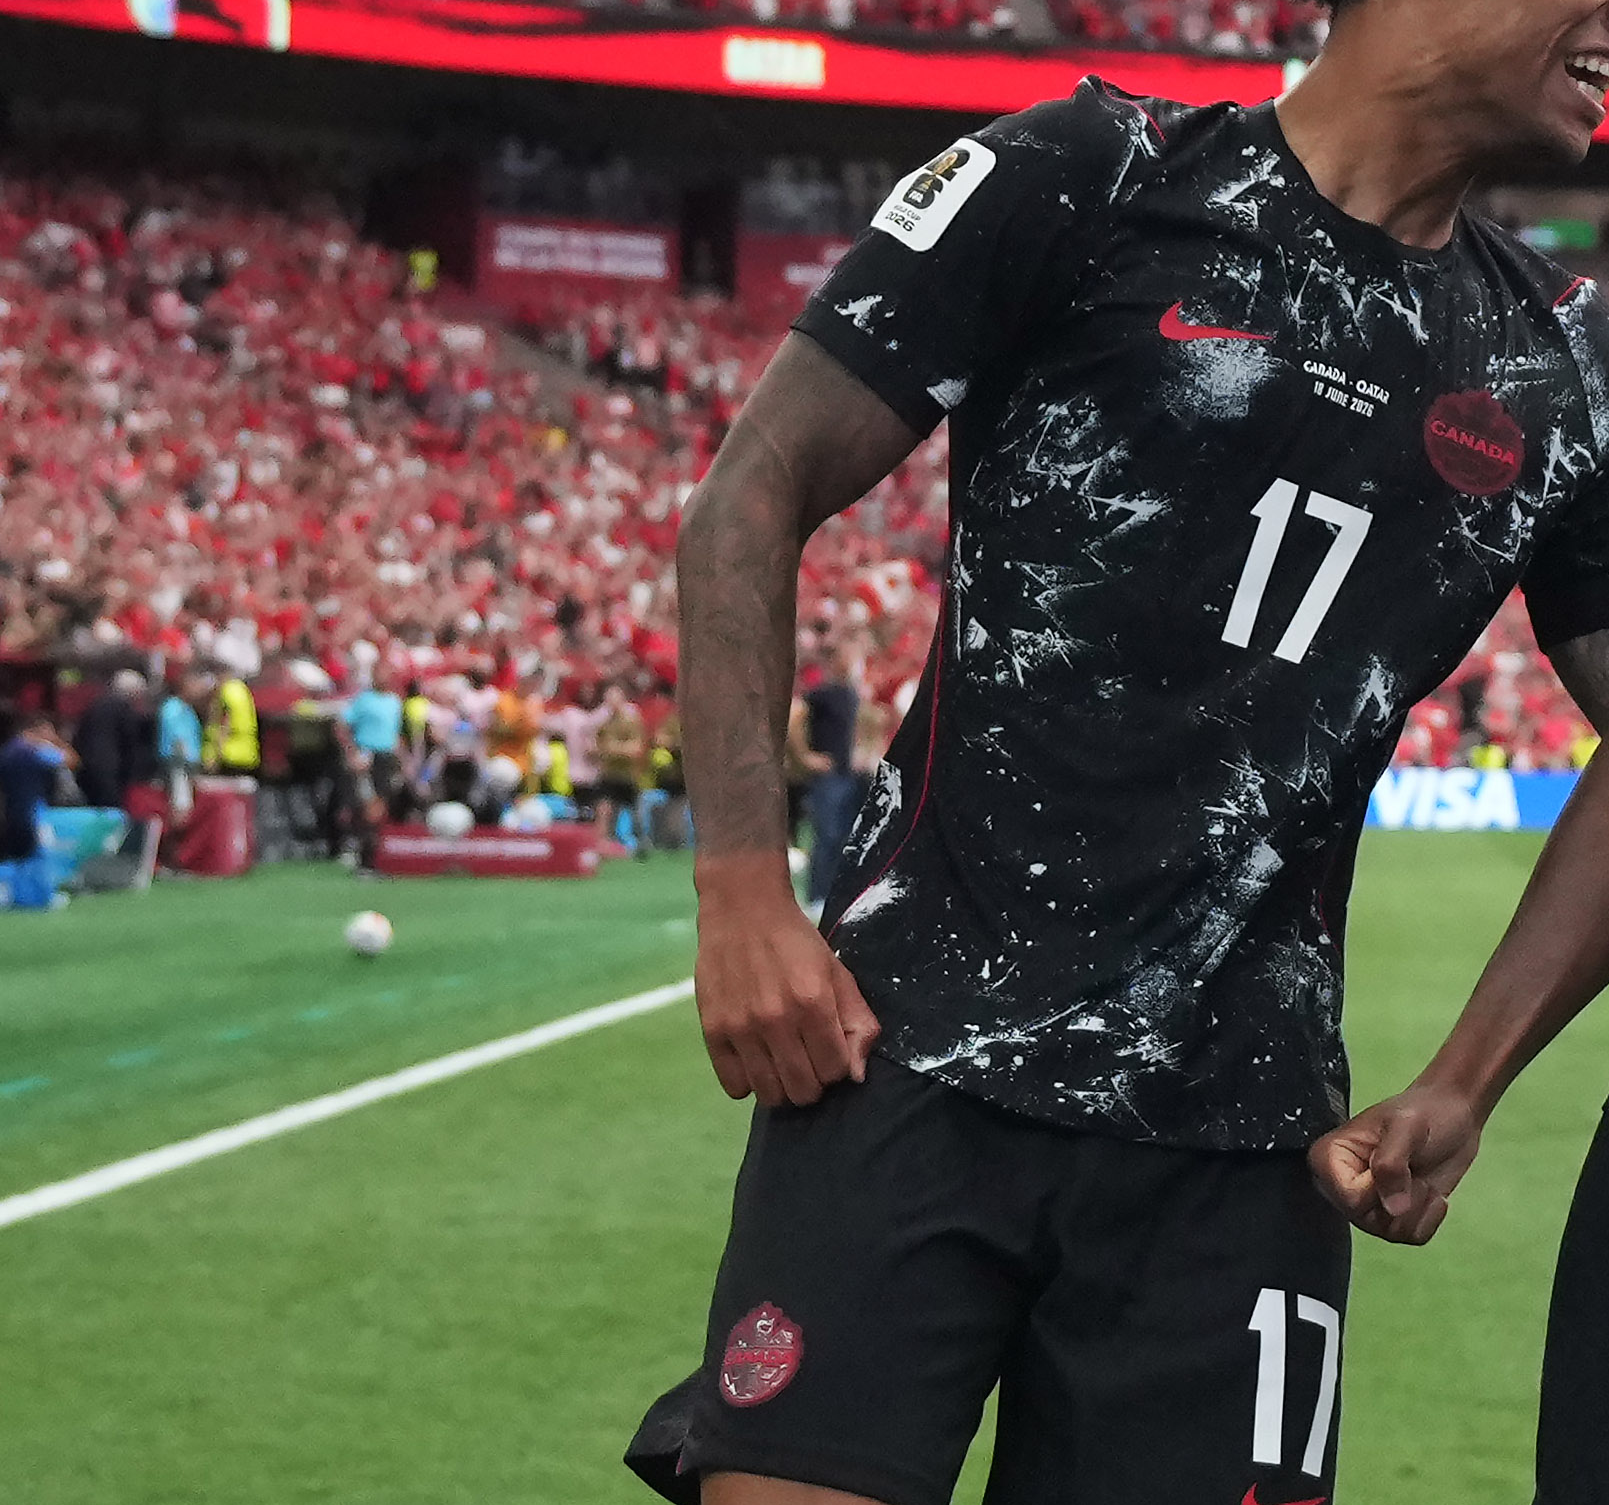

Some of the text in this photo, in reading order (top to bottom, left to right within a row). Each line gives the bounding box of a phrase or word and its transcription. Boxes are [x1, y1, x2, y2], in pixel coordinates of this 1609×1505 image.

[1303, 360, 1347, 385] CANADA
[1356, 379, 1390, 405] QATAR
[1313, 380, 1375, 418] 18 JUNE 2026
[1430, 419, 1517, 466] CANADA
[1221, 477, 1374, 664] 17
[1371, 766, 1522, 831] VISA
[1248, 1287, 1340, 1478] 17
